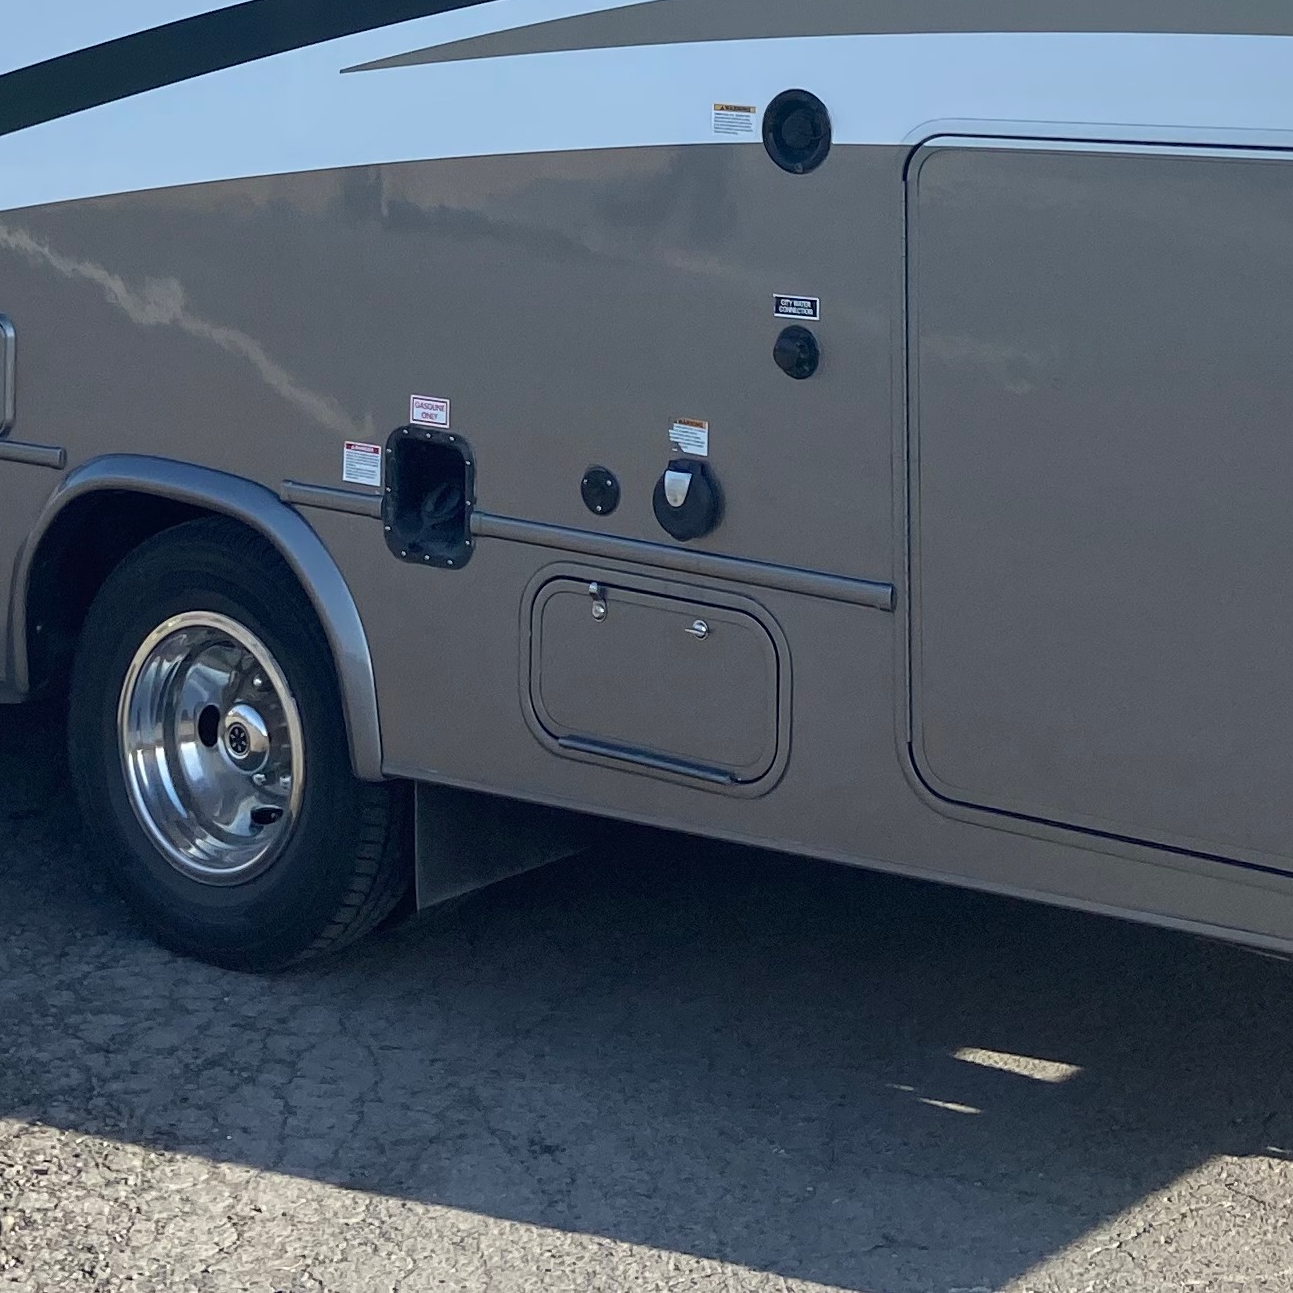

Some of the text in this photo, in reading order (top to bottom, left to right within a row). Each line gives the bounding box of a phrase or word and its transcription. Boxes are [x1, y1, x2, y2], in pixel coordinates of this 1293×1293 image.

[780, 298, 793, 307] CITY
[778, 306, 814, 315] CONNECTION
[415, 401, 445, 413] GASOLINE
[421, 411, 438, 420] ONLY
